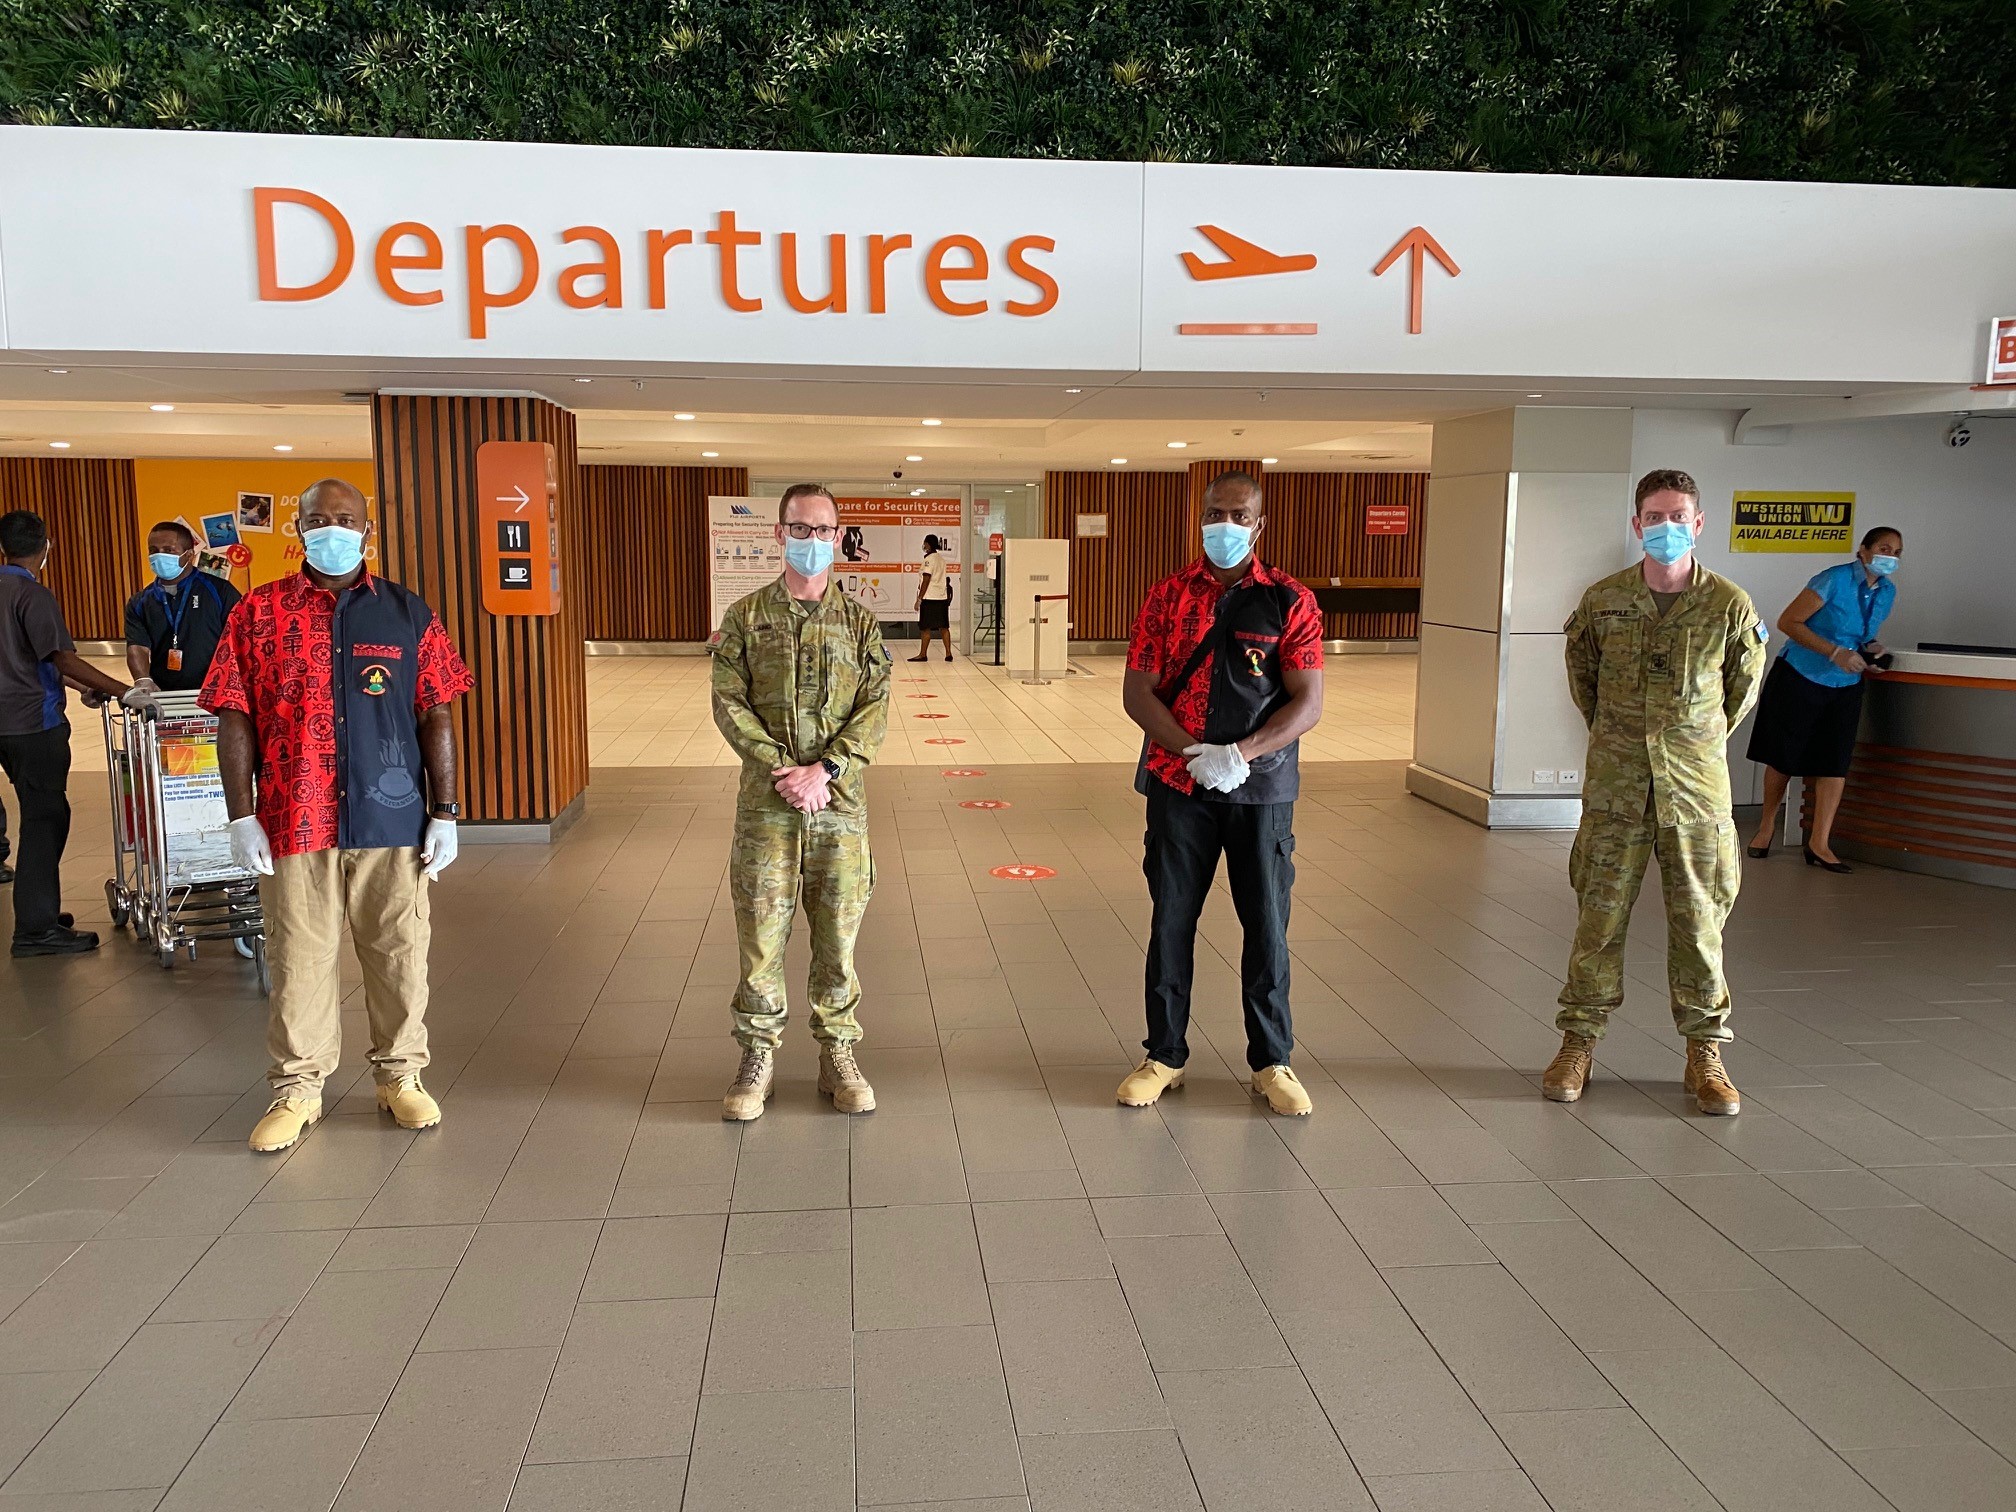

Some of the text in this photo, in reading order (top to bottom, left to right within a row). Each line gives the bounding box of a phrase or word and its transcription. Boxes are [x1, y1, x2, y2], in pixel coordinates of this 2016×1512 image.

[253, 186, 1060, 339] Departures
[838, 502, 861, 514] pare
[865, 501, 881, 511] for
[884, 501, 929, 513] Security
[1740, 504, 1845, 524] WESTERN WU
[1759, 514, 1801, 523] UNION
[1736, 529, 1848, 540] AVAILABLE HERE
[209, 790, 225, 798] TWO
